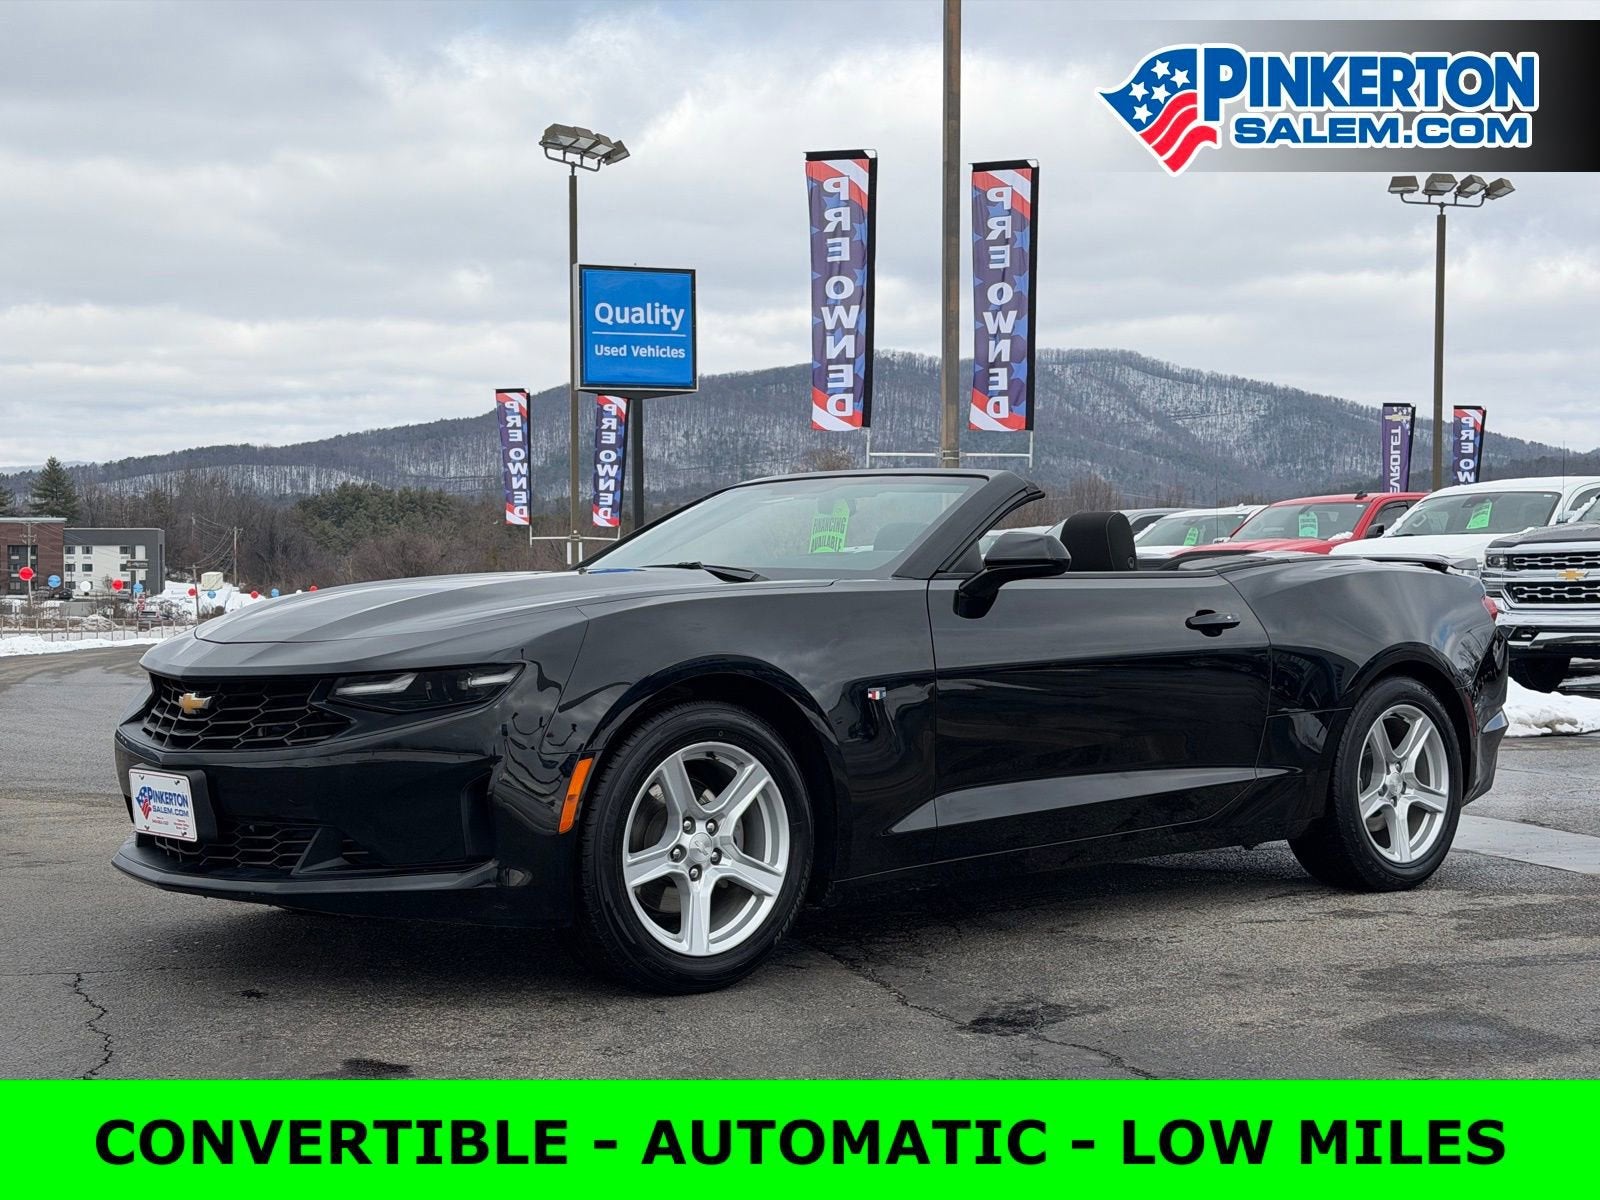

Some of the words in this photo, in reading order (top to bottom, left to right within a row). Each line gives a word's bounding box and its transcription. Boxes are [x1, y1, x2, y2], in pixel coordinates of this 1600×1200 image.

[594, 302, 685, 331] Quality
[594, 344, 627, 357] Used
[631, 345, 686, 358] Vehicles
[147, 786, 189, 808] PINKERTON
[152, 805, 190, 817] SALEM.COM
